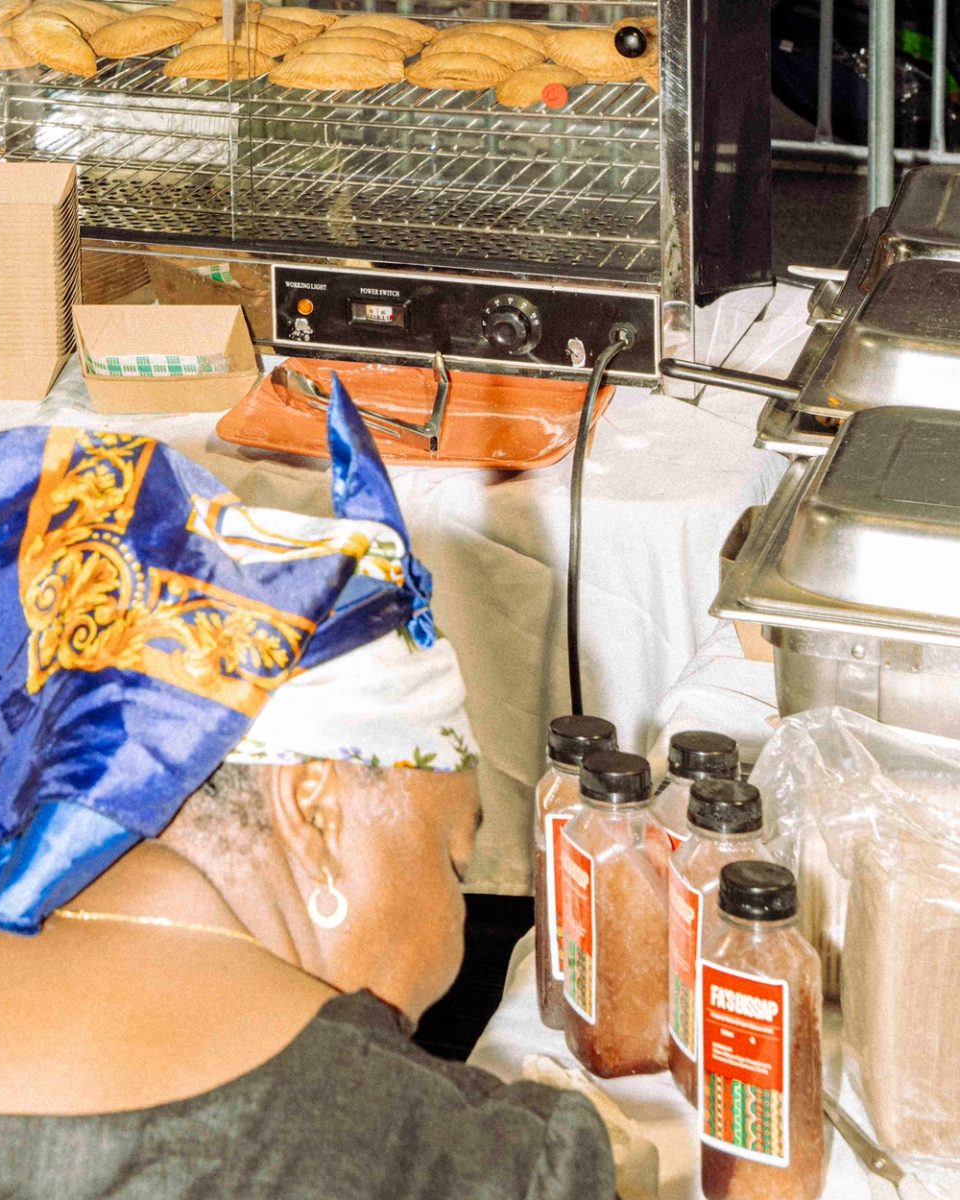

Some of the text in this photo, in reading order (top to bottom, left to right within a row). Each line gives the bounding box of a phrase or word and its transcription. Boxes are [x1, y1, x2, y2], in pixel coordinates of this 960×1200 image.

[285, 281, 327, 291] WORKING LIGHT
[360, 287, 400, 297] POWER SWITCH
